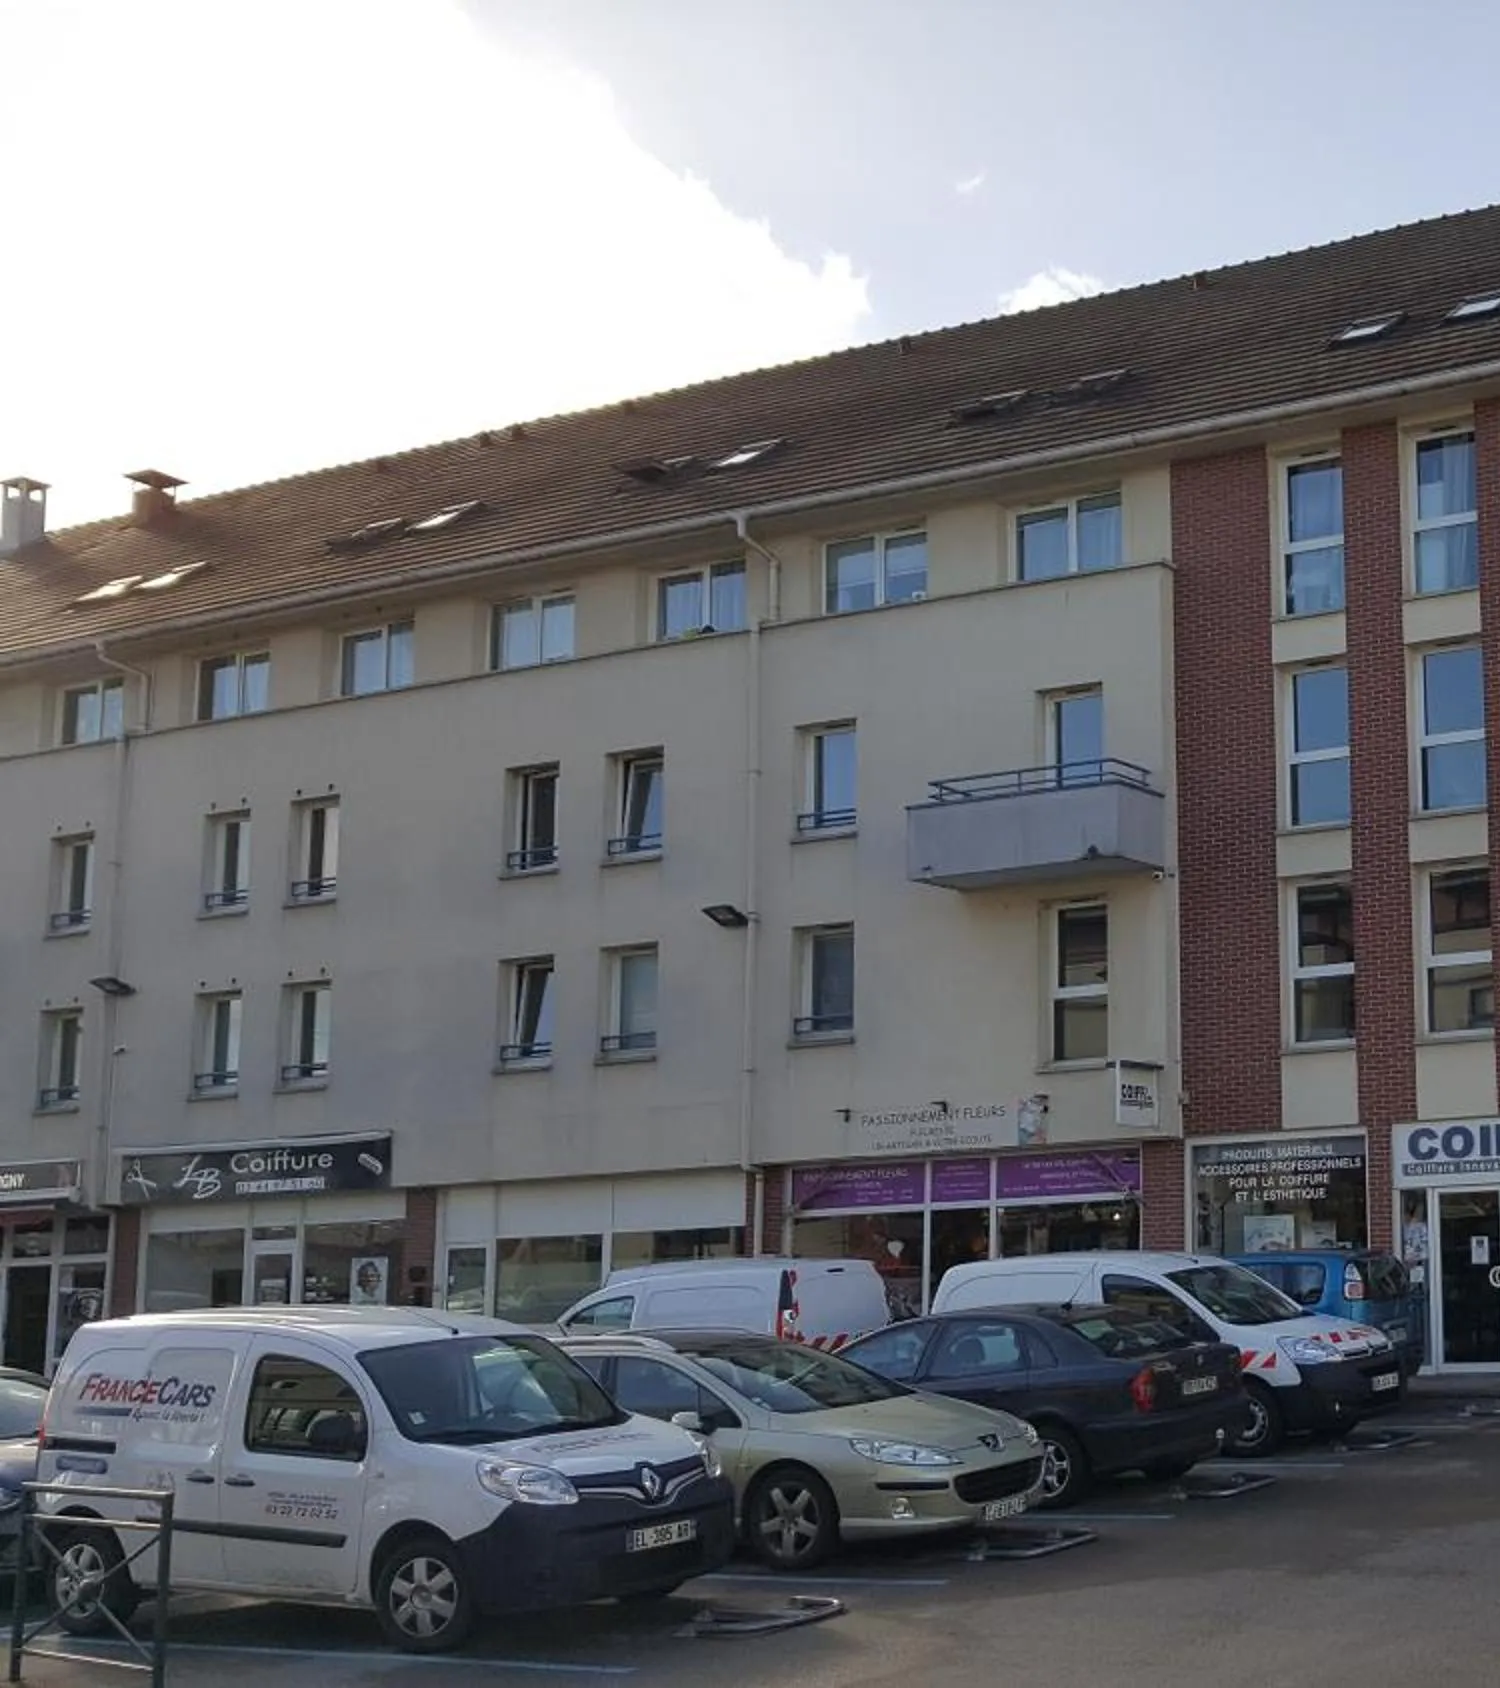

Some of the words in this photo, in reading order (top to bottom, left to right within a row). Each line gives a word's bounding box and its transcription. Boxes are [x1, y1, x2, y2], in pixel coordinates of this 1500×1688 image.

[231, 1149, 333, 1174] Coiffure
[1271, 1157, 1362, 1173] PROFESSIONNELS
[1229, 1177, 1257, 1189] POUR
[1262, 1176, 1275, 1187] LA
[1279, 1173, 1330, 1186] COIFFURE
[1235, 1191, 1249, 1203] ET
